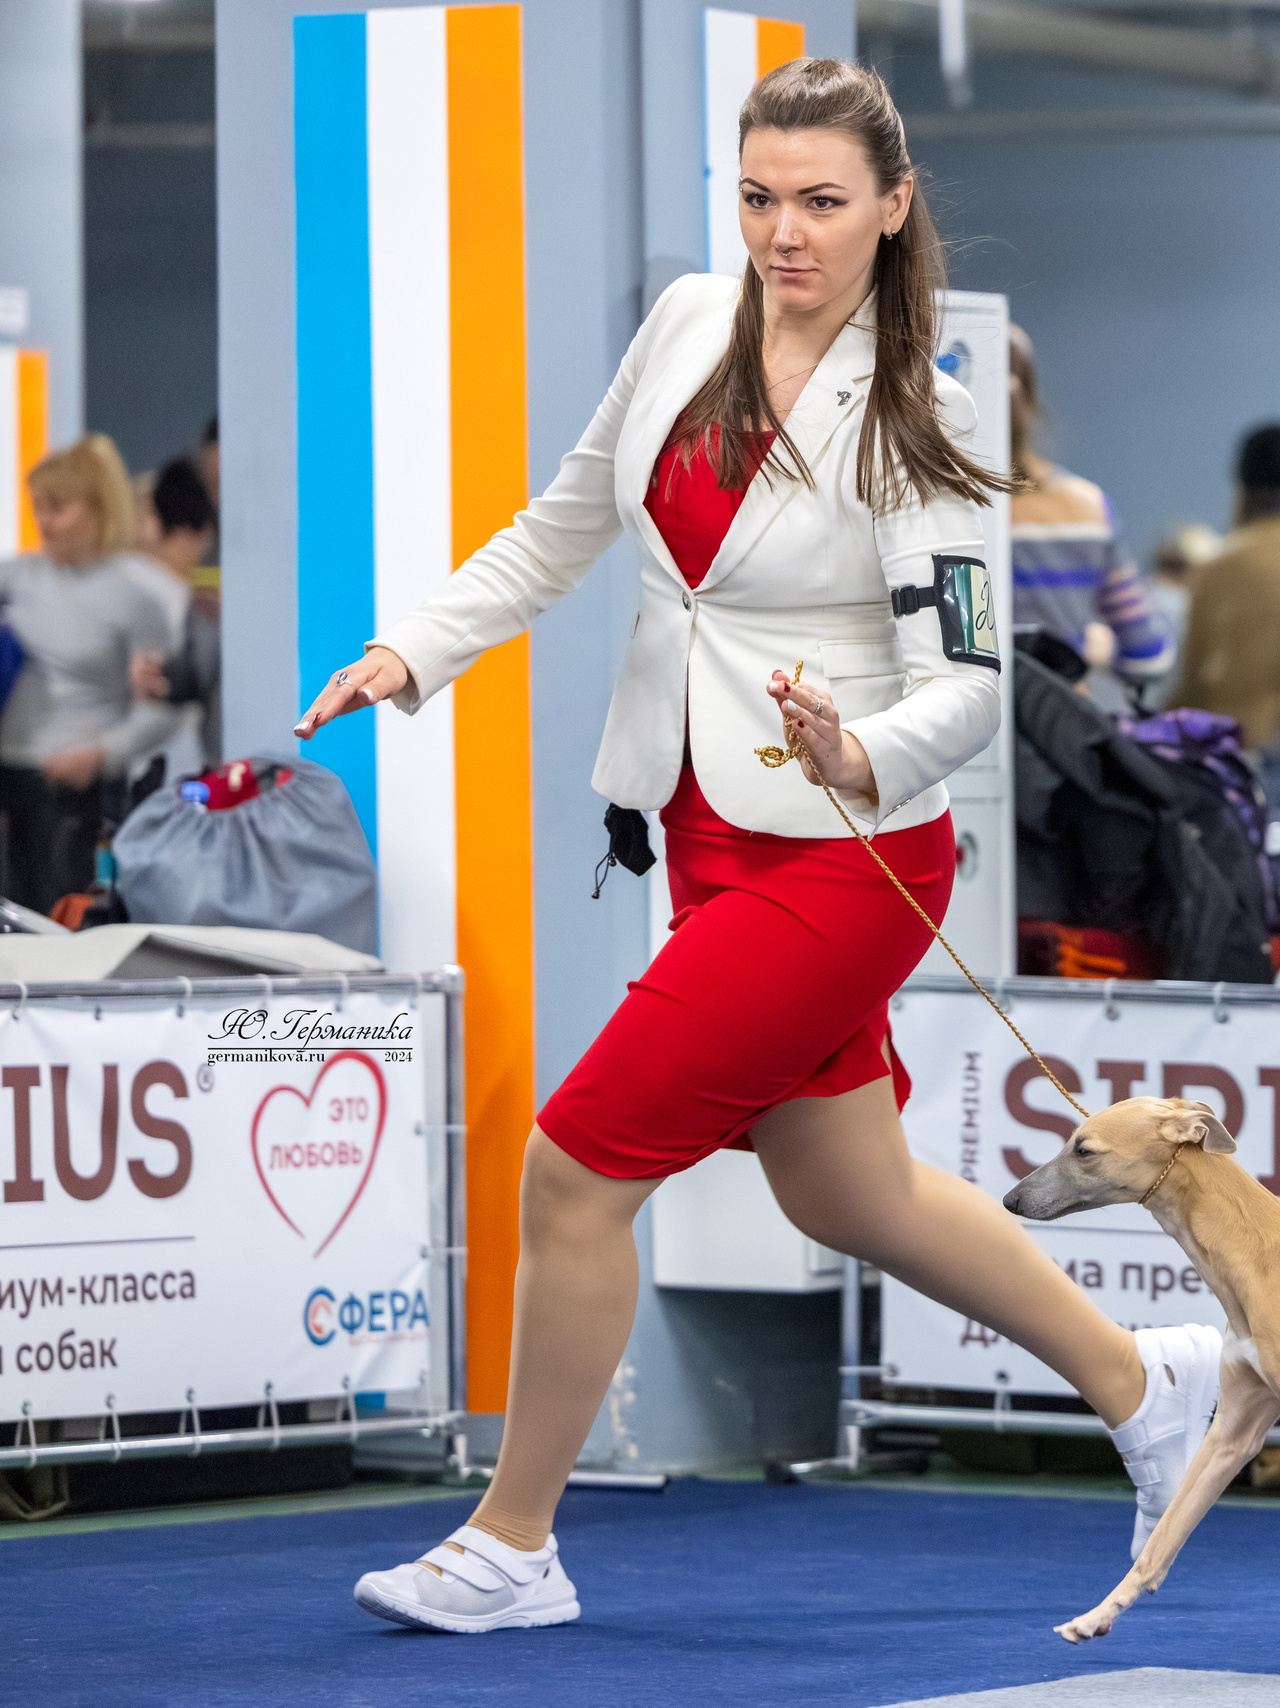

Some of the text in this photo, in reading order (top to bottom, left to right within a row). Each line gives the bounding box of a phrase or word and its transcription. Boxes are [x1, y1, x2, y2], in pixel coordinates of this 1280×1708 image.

[329, 1097, 369, 1123] ЭТО
[960, 1052, 980, 1183] PREMIUM
[269, 1142, 364, 1170] ЛЮБОВЬ
[303, 1285, 430, 1346] СФЕРА
[16, 1328, 118, 1374] собак
